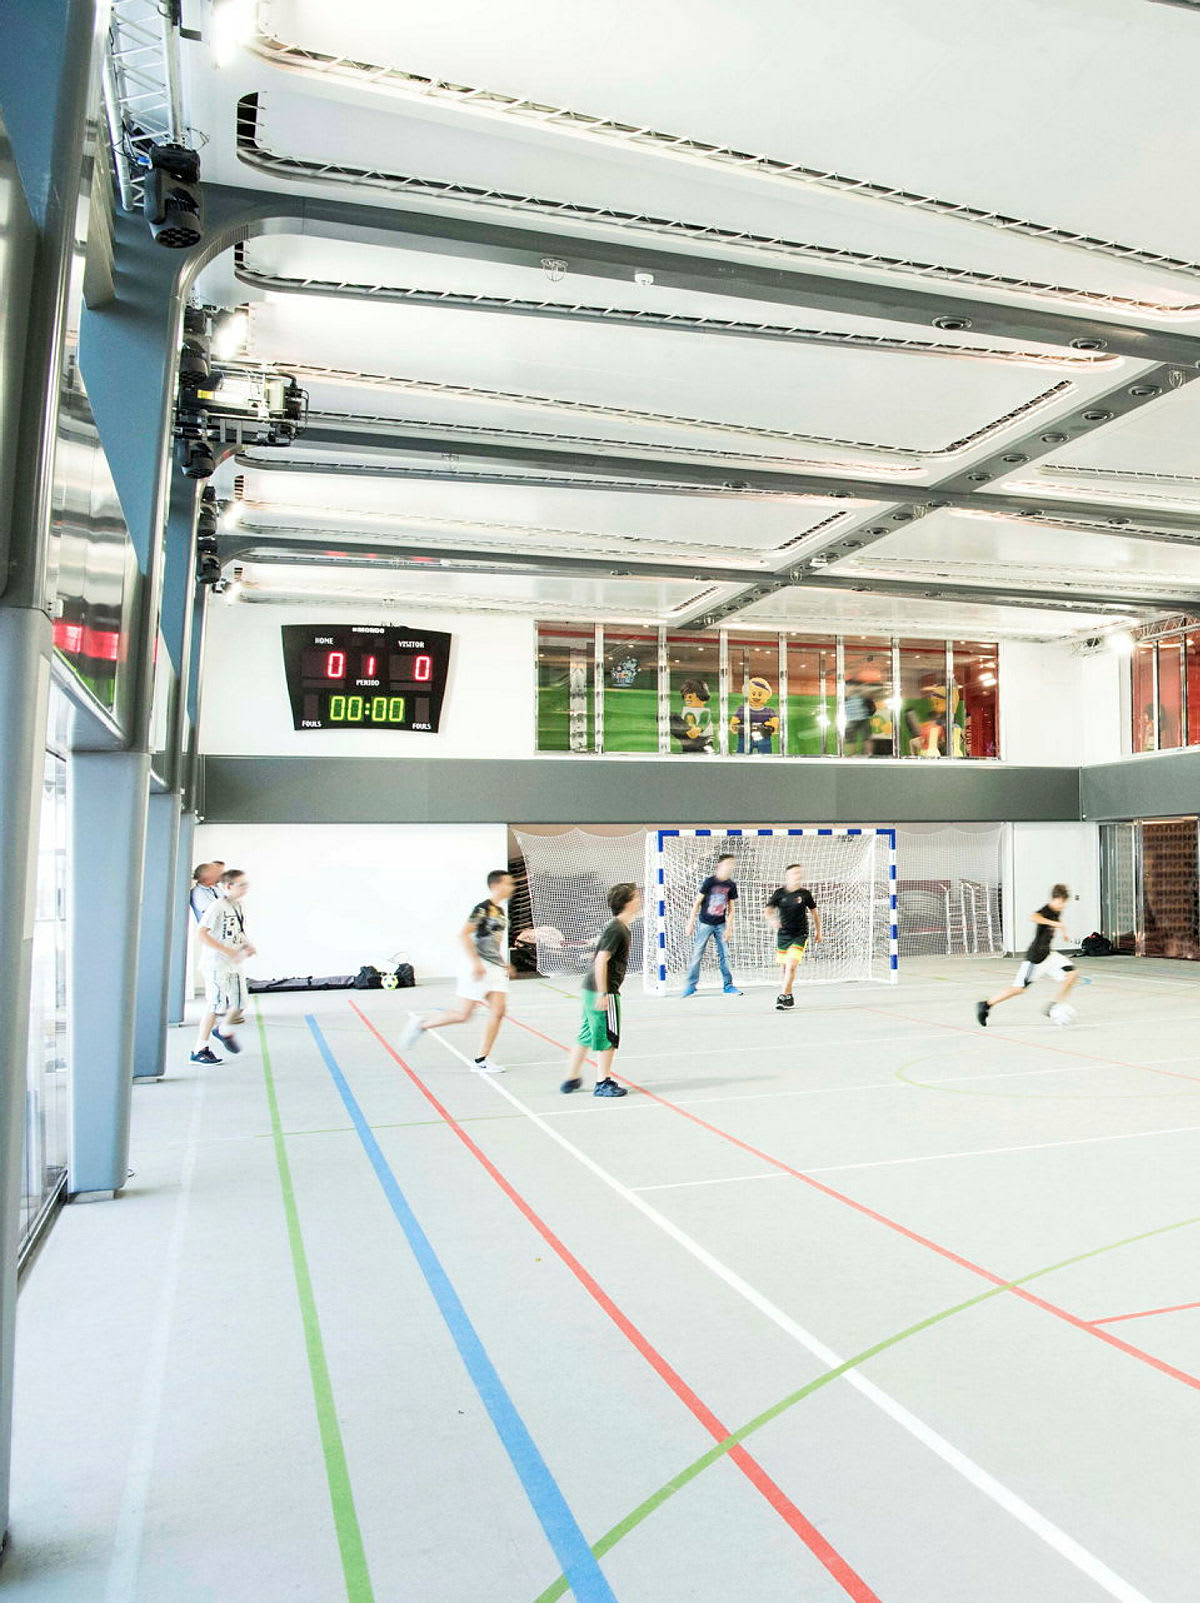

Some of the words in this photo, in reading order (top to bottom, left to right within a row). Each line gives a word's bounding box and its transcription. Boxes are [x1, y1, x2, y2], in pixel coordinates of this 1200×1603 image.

[315, 637, 334, 645] HOME
[398, 640, 425, 649] VISITOR
[327, 652, 344, 678] 0
[367, 656, 375, 676] 1
[414, 656, 431, 681] 0
[356, 679, 380, 687] PERIOD
[330, 696, 404, 722] 00:00
[302, 720, 322, 728] FOULS
